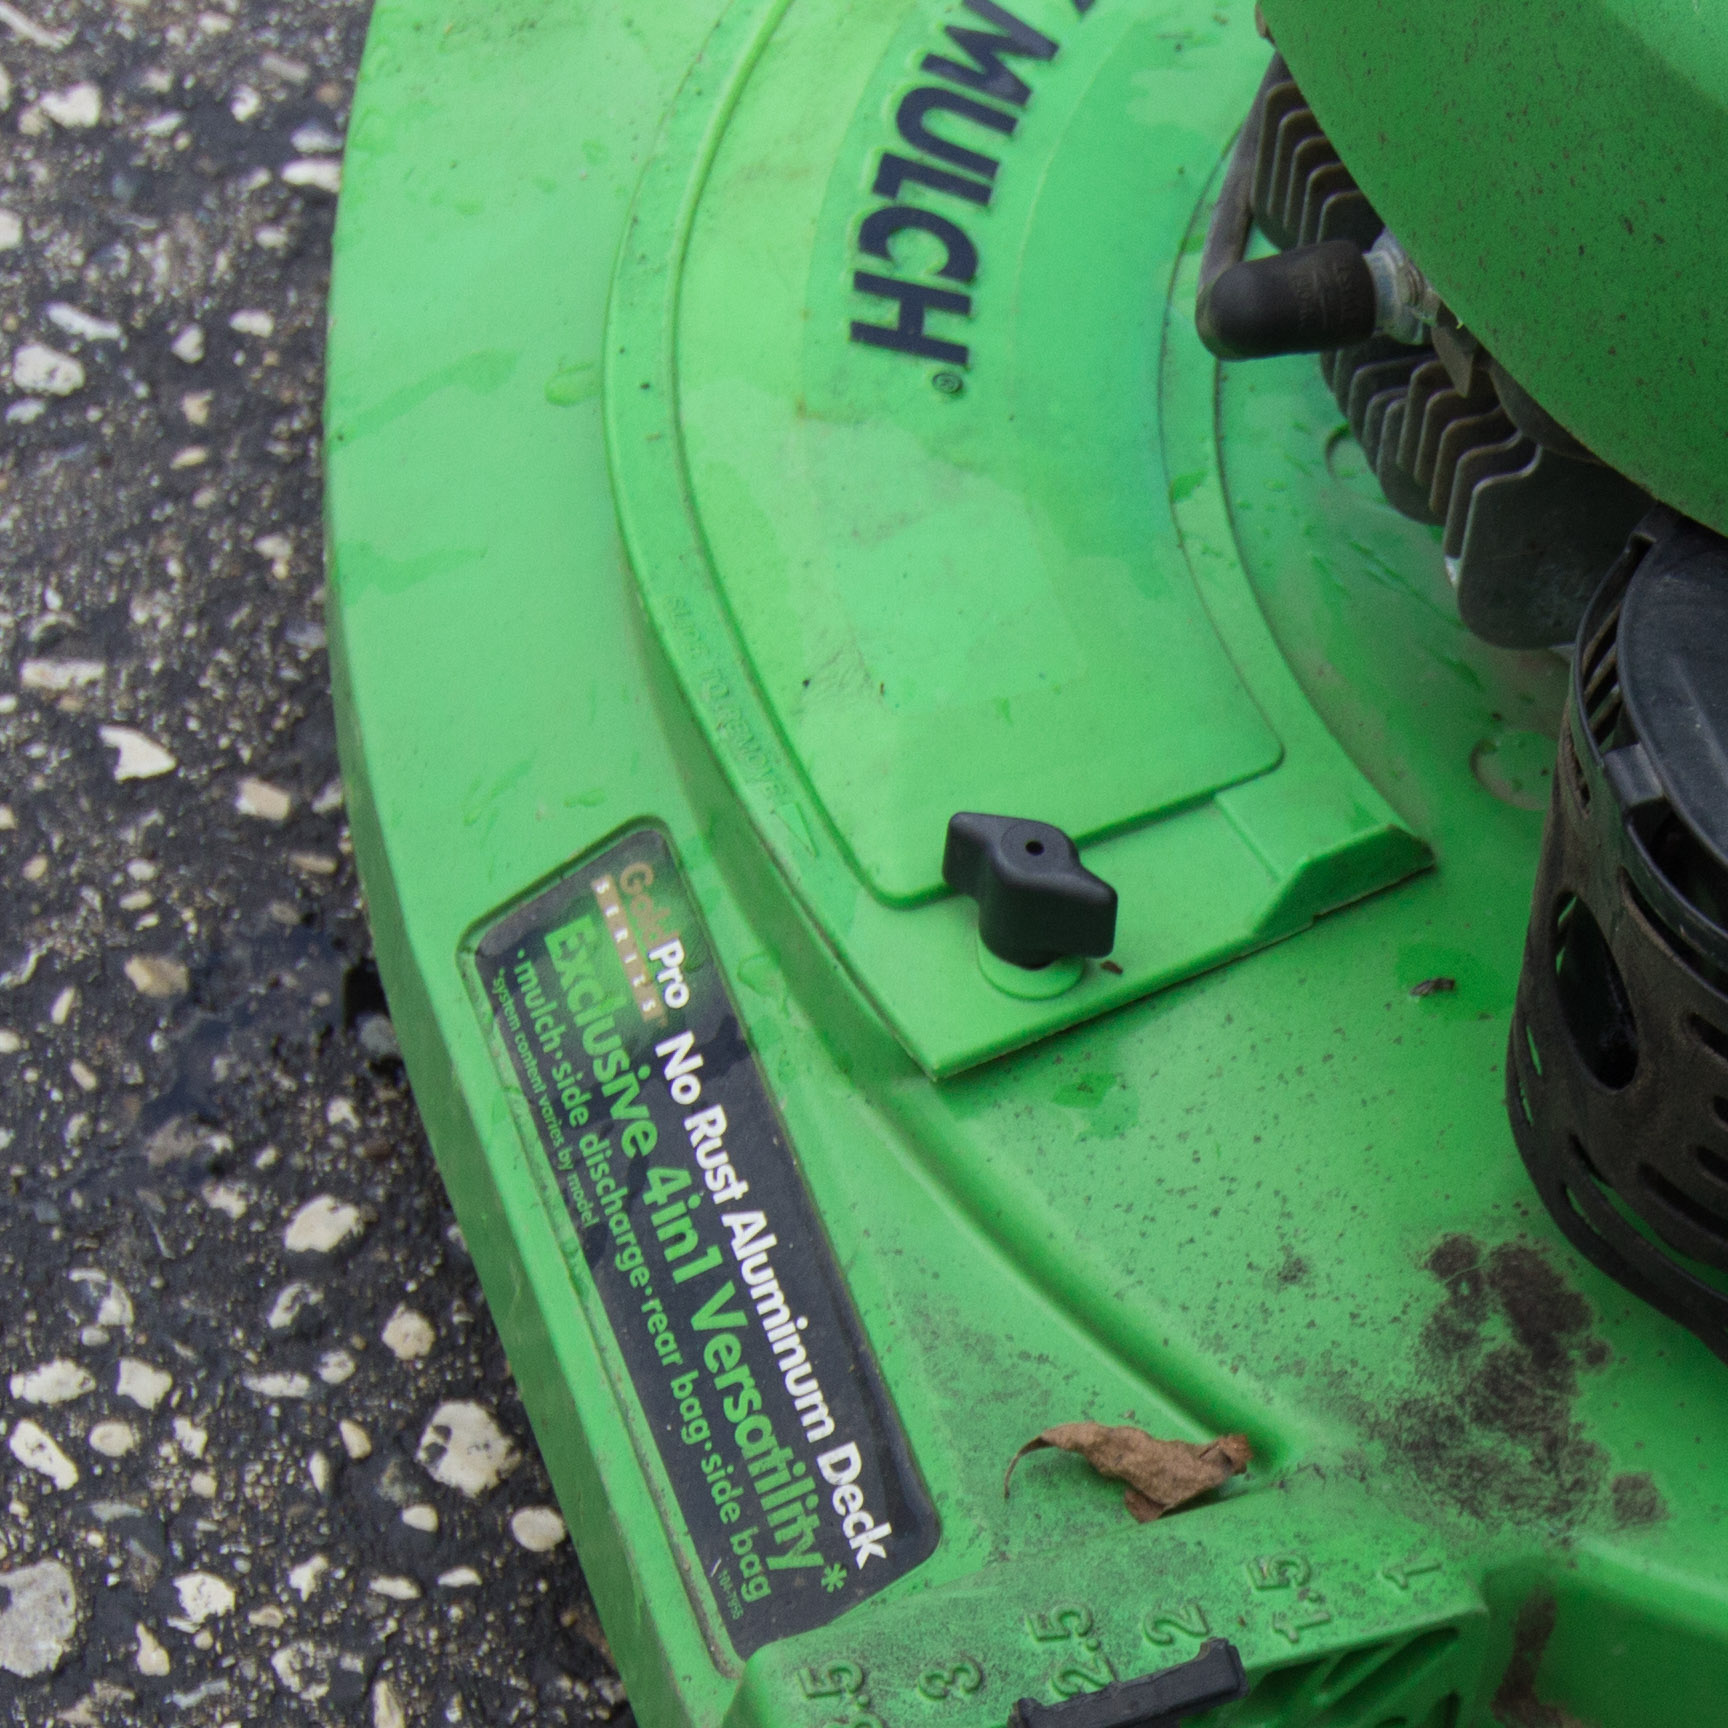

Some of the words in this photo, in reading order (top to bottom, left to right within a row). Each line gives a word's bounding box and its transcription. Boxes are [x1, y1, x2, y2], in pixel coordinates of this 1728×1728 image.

[515, 1033, 545, 1092] content
[539, 1093, 563, 1146] varies
[556, 1146, 578, 1172] by
[567, 1173, 598, 1225] model
[545, 912, 656, 1156] Exclusive
[643, 1168, 722, 1282] 4in1
[656, 1032, 702, 1103] No
[685, 1105, 747, 1203] Rust
[722, 1211, 833, 1441] Aluminum
[817, 1442, 890, 1568] Deck
[730, 1527, 774, 1601] bag
[1142, 1602, 1210, 1647] 2
[918, 1656, 982, 1701] 3
